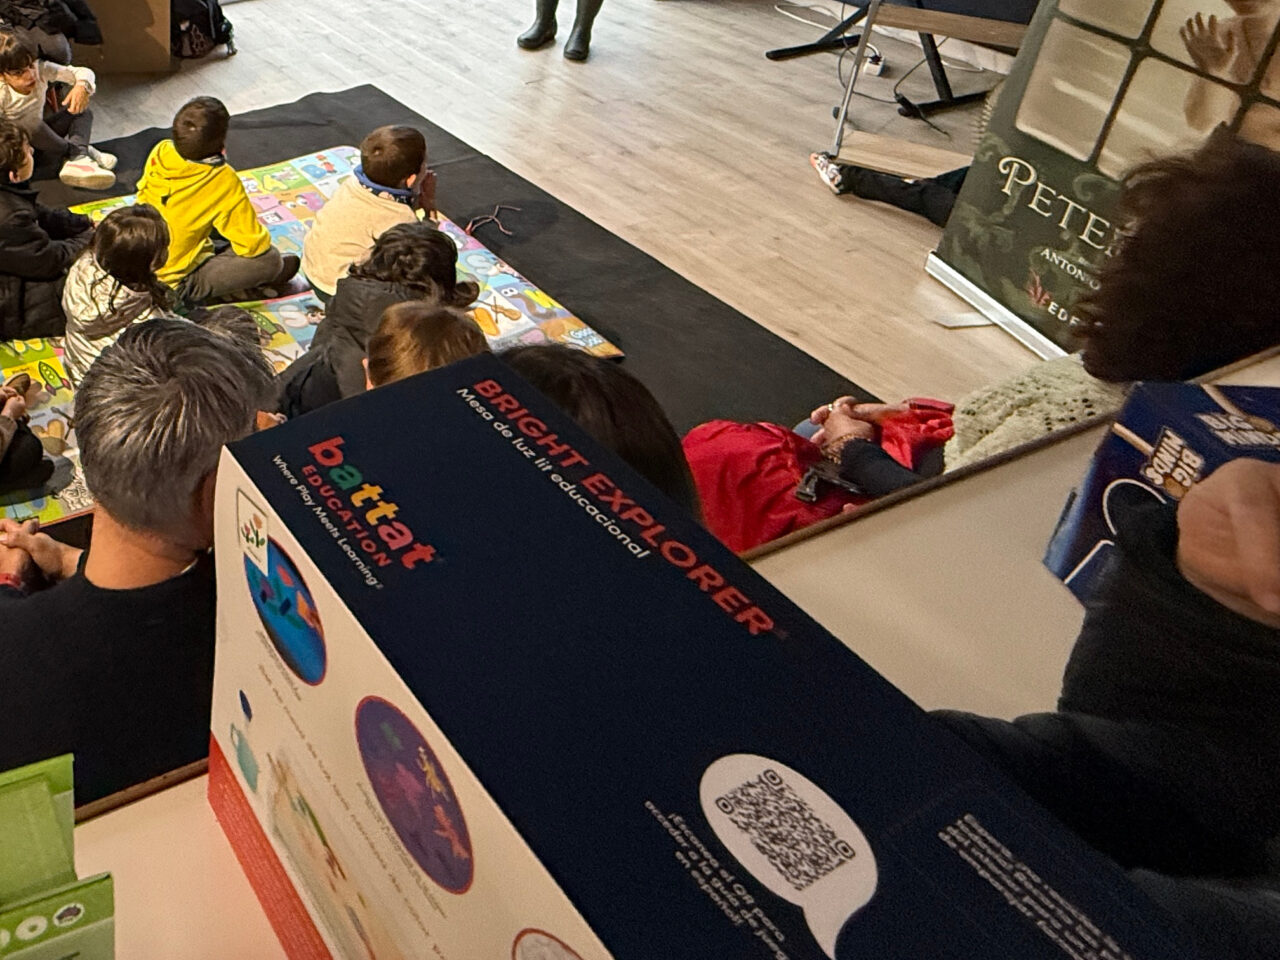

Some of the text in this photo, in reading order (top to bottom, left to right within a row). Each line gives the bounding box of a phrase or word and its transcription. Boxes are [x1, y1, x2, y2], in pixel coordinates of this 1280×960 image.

[272, 454, 299, 486] Where
[296, 484, 317, 508] Play
[312, 506, 340, 539] Meets
[456, 387, 651, 559] Mesa de luz lit educacional
[1145, 428, 1184, 486] MINDS
[1171, 447, 1203, 488] BIG
[301, 464, 393, 568] EDUCATION
[307, 435, 437, 570] battat
[473, 378, 775, 636] BRIGHT EXPLORER
[644, 800, 690, 848] acceder
[688, 850, 699, 860] a
[698, 861, 712, 875] la
[675, 850, 691, 869] en
[719, 868, 736, 882] el
[732, 883, 755, 904] QR
[751, 907, 785, 941] para
